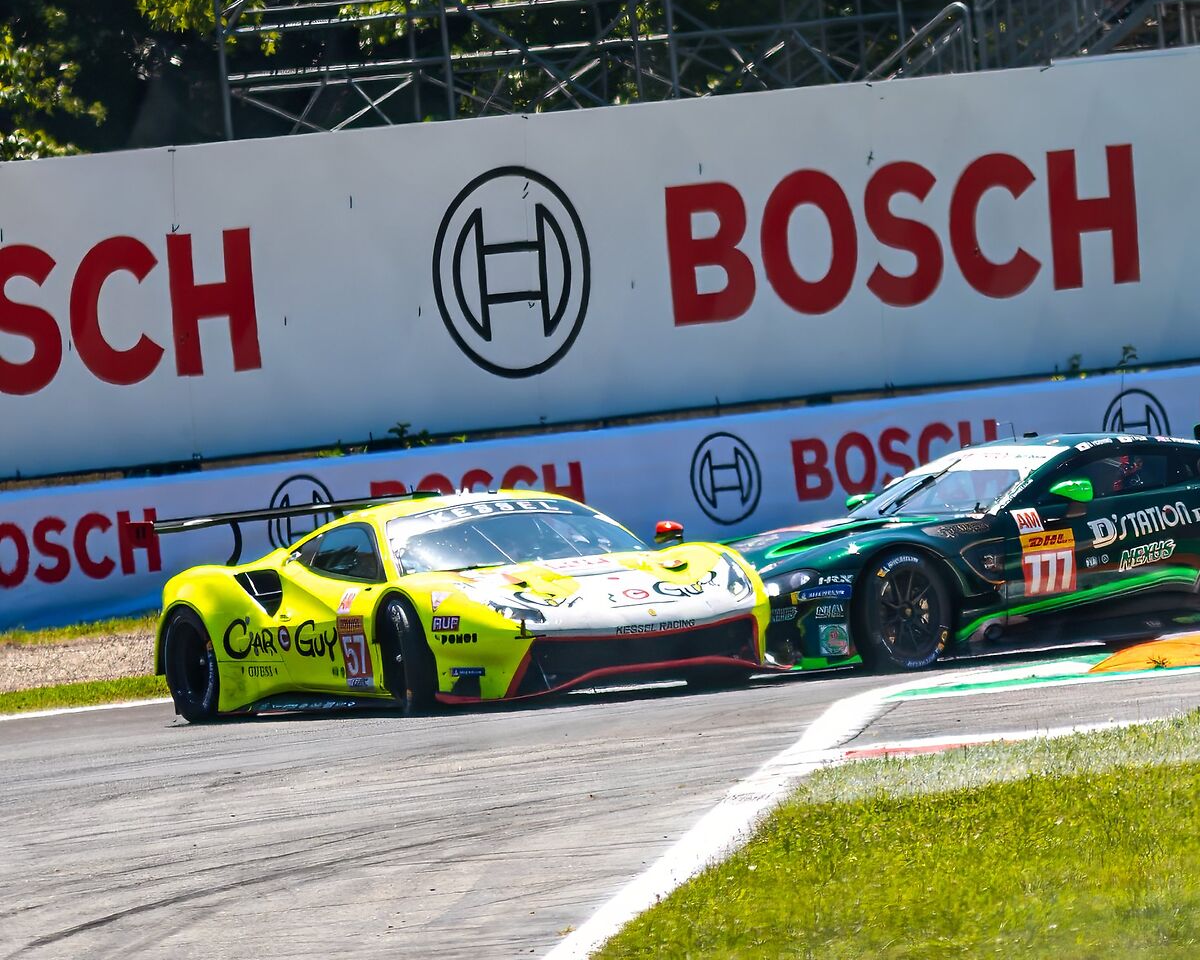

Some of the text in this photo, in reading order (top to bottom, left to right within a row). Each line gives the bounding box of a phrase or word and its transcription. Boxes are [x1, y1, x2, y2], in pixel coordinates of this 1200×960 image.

[665, 143, 1140, 327] BOSCH
[428, 501, 561, 524] KESSEL
[1016, 511, 1042, 530] AM
[1024, 550, 1074, 593] 777
[1118, 539, 1177, 572] NEXUS
[616, 618, 696, 635] KESSEL RACING
[341, 634, 367, 676] 57
